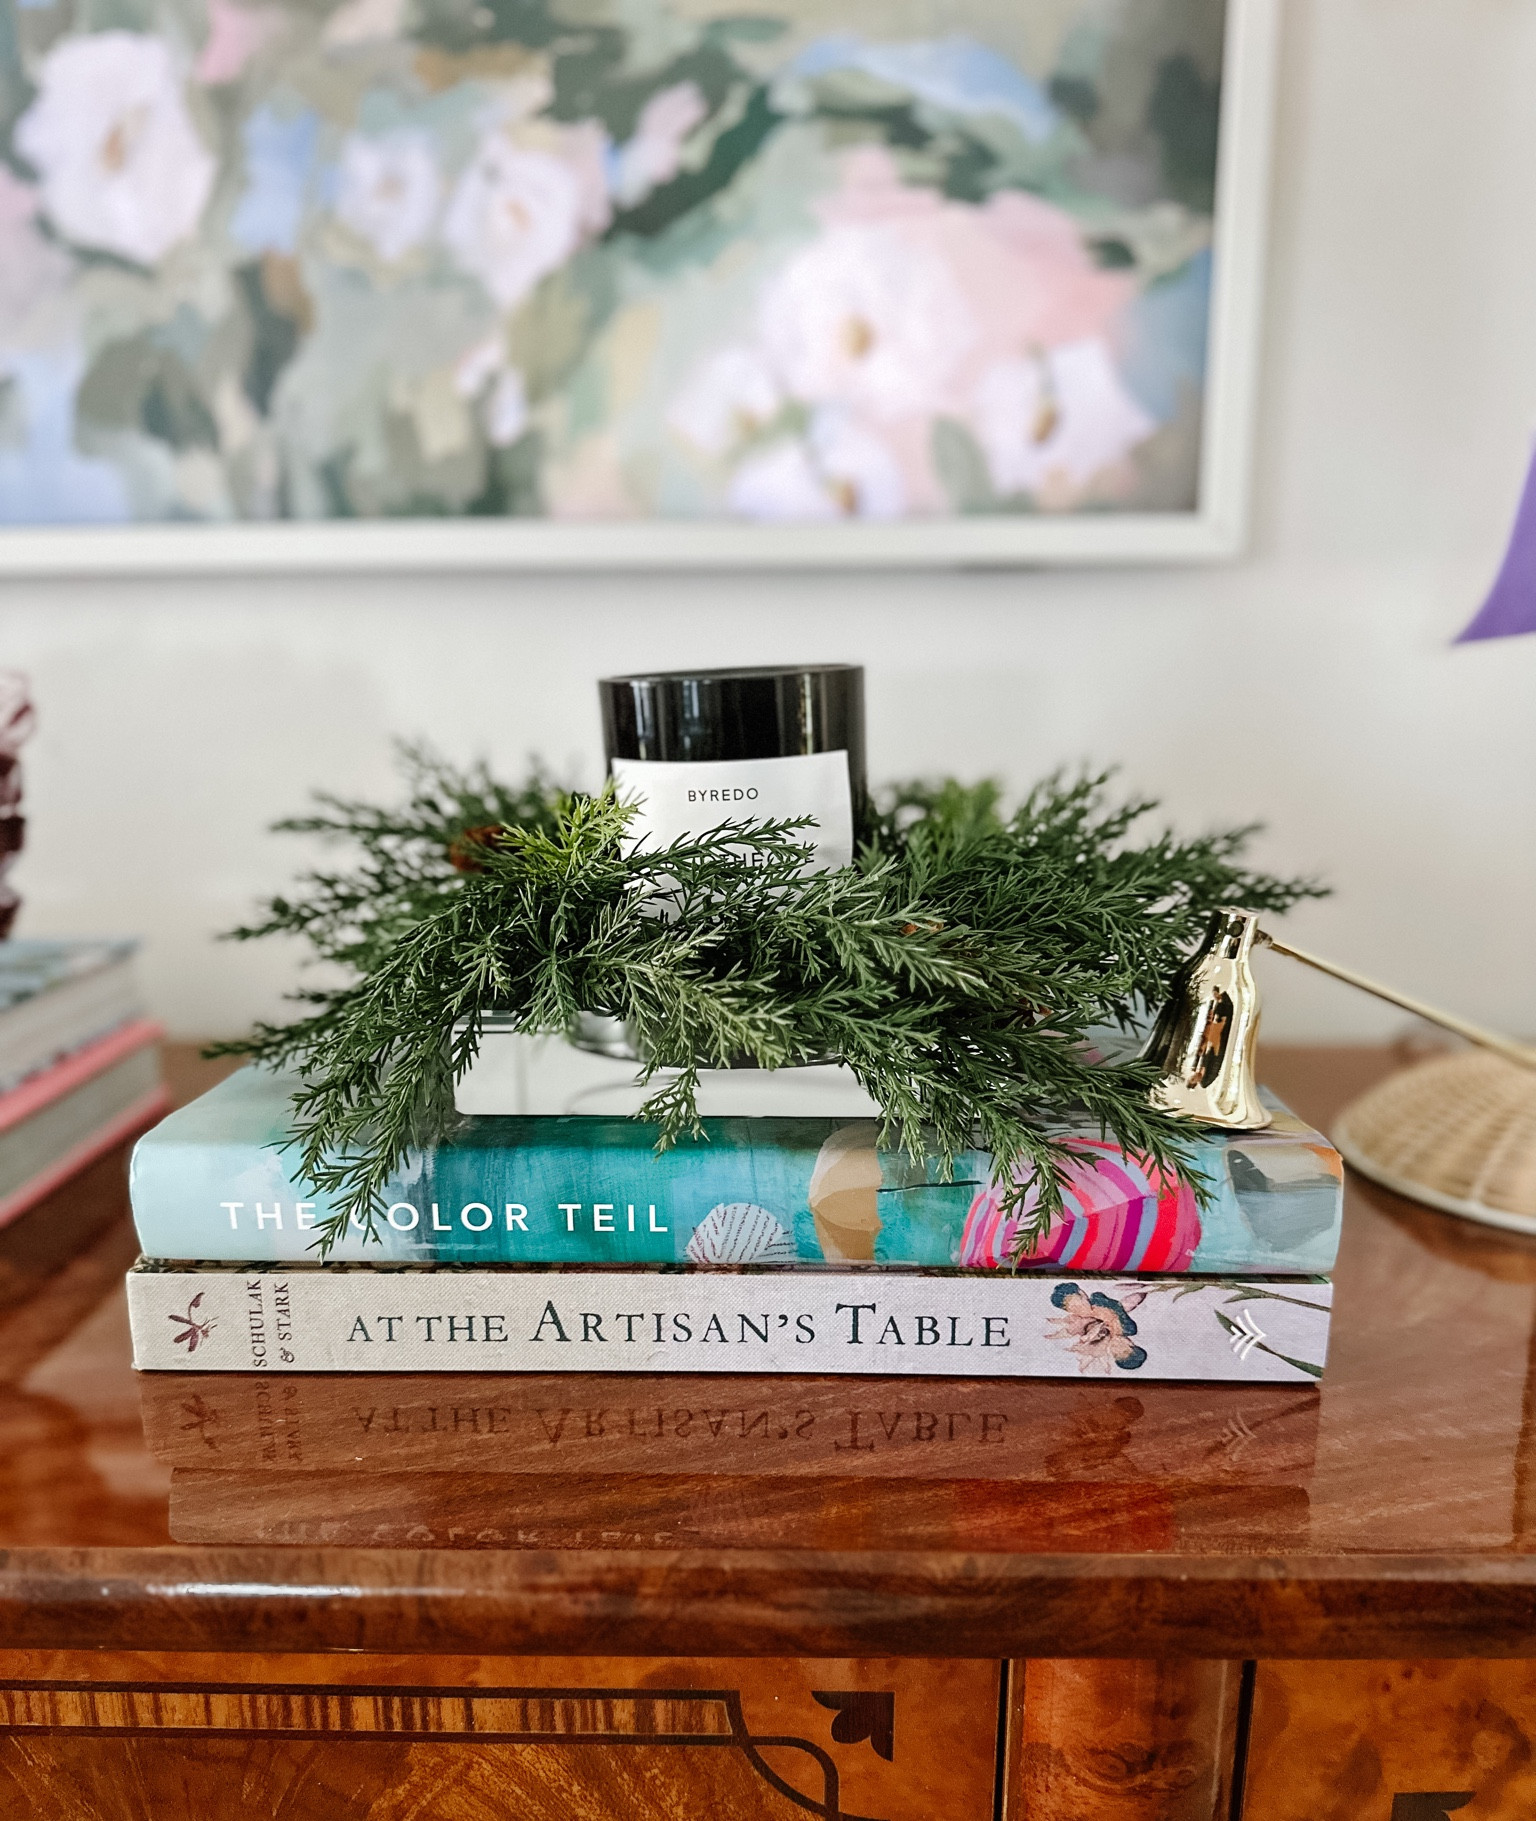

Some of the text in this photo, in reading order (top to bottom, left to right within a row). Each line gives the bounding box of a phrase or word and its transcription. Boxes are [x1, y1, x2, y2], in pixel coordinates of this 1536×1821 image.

[688, 788, 759, 802] BYREDO
[220, 1202, 668, 1233] THE COLOR TEIL
[247, 1279, 267, 1367] SCHULAK
[274, 1282, 295, 1363] & STARK
[347, 1300, 1011, 1347] AT THE ARTISAN'S TABLE
